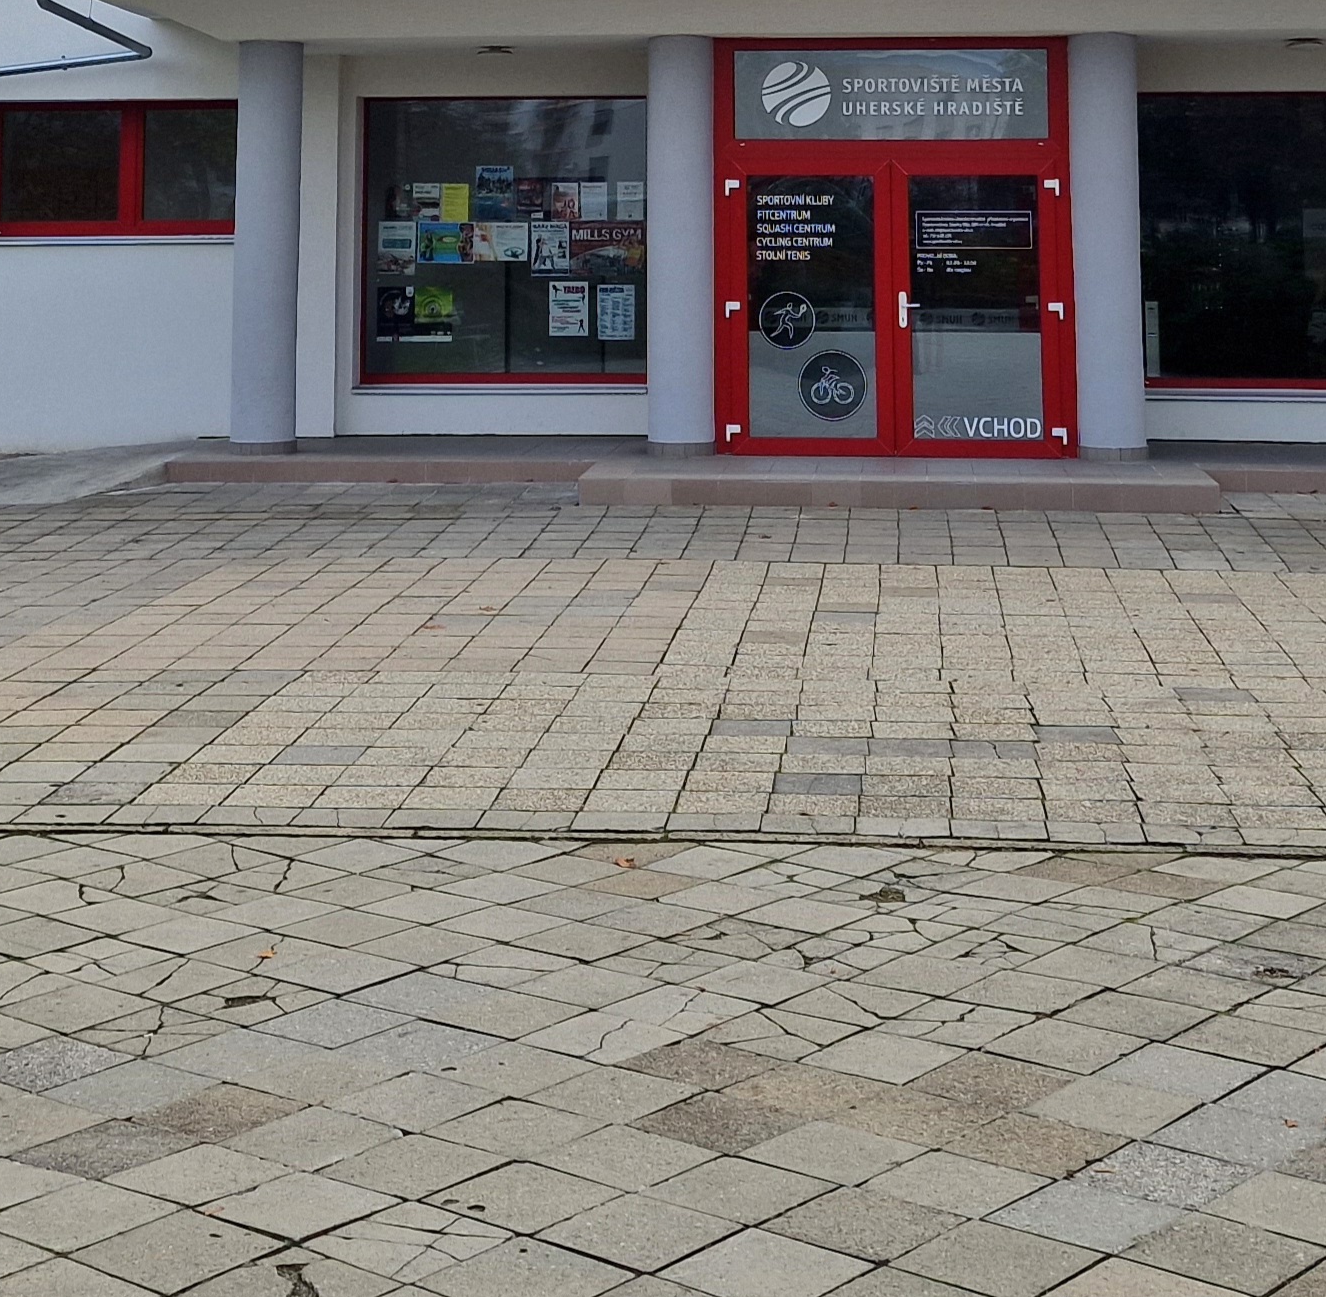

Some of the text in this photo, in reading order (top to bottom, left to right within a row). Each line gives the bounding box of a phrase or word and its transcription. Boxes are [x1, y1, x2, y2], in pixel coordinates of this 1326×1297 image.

[841, 74, 1024, 93] SPORTOVIŠTĚ MĚSTA
[841, 97, 1024, 116] UHERSKÉ HRADIŠTĚ
[756, 193, 835, 206] SPORTOVNÍ KLUBY
[757, 209, 811, 220] FITCENTRUM
[571, 228, 642, 241] MILLS GYM
[756, 223, 836, 234] SQUASH CENTRUM
[756, 237, 833, 247] CYCLING CENTRUM
[756, 249, 811, 260] STOLNÍ TENIS
[963, 417, 1042, 438] VCHOD
